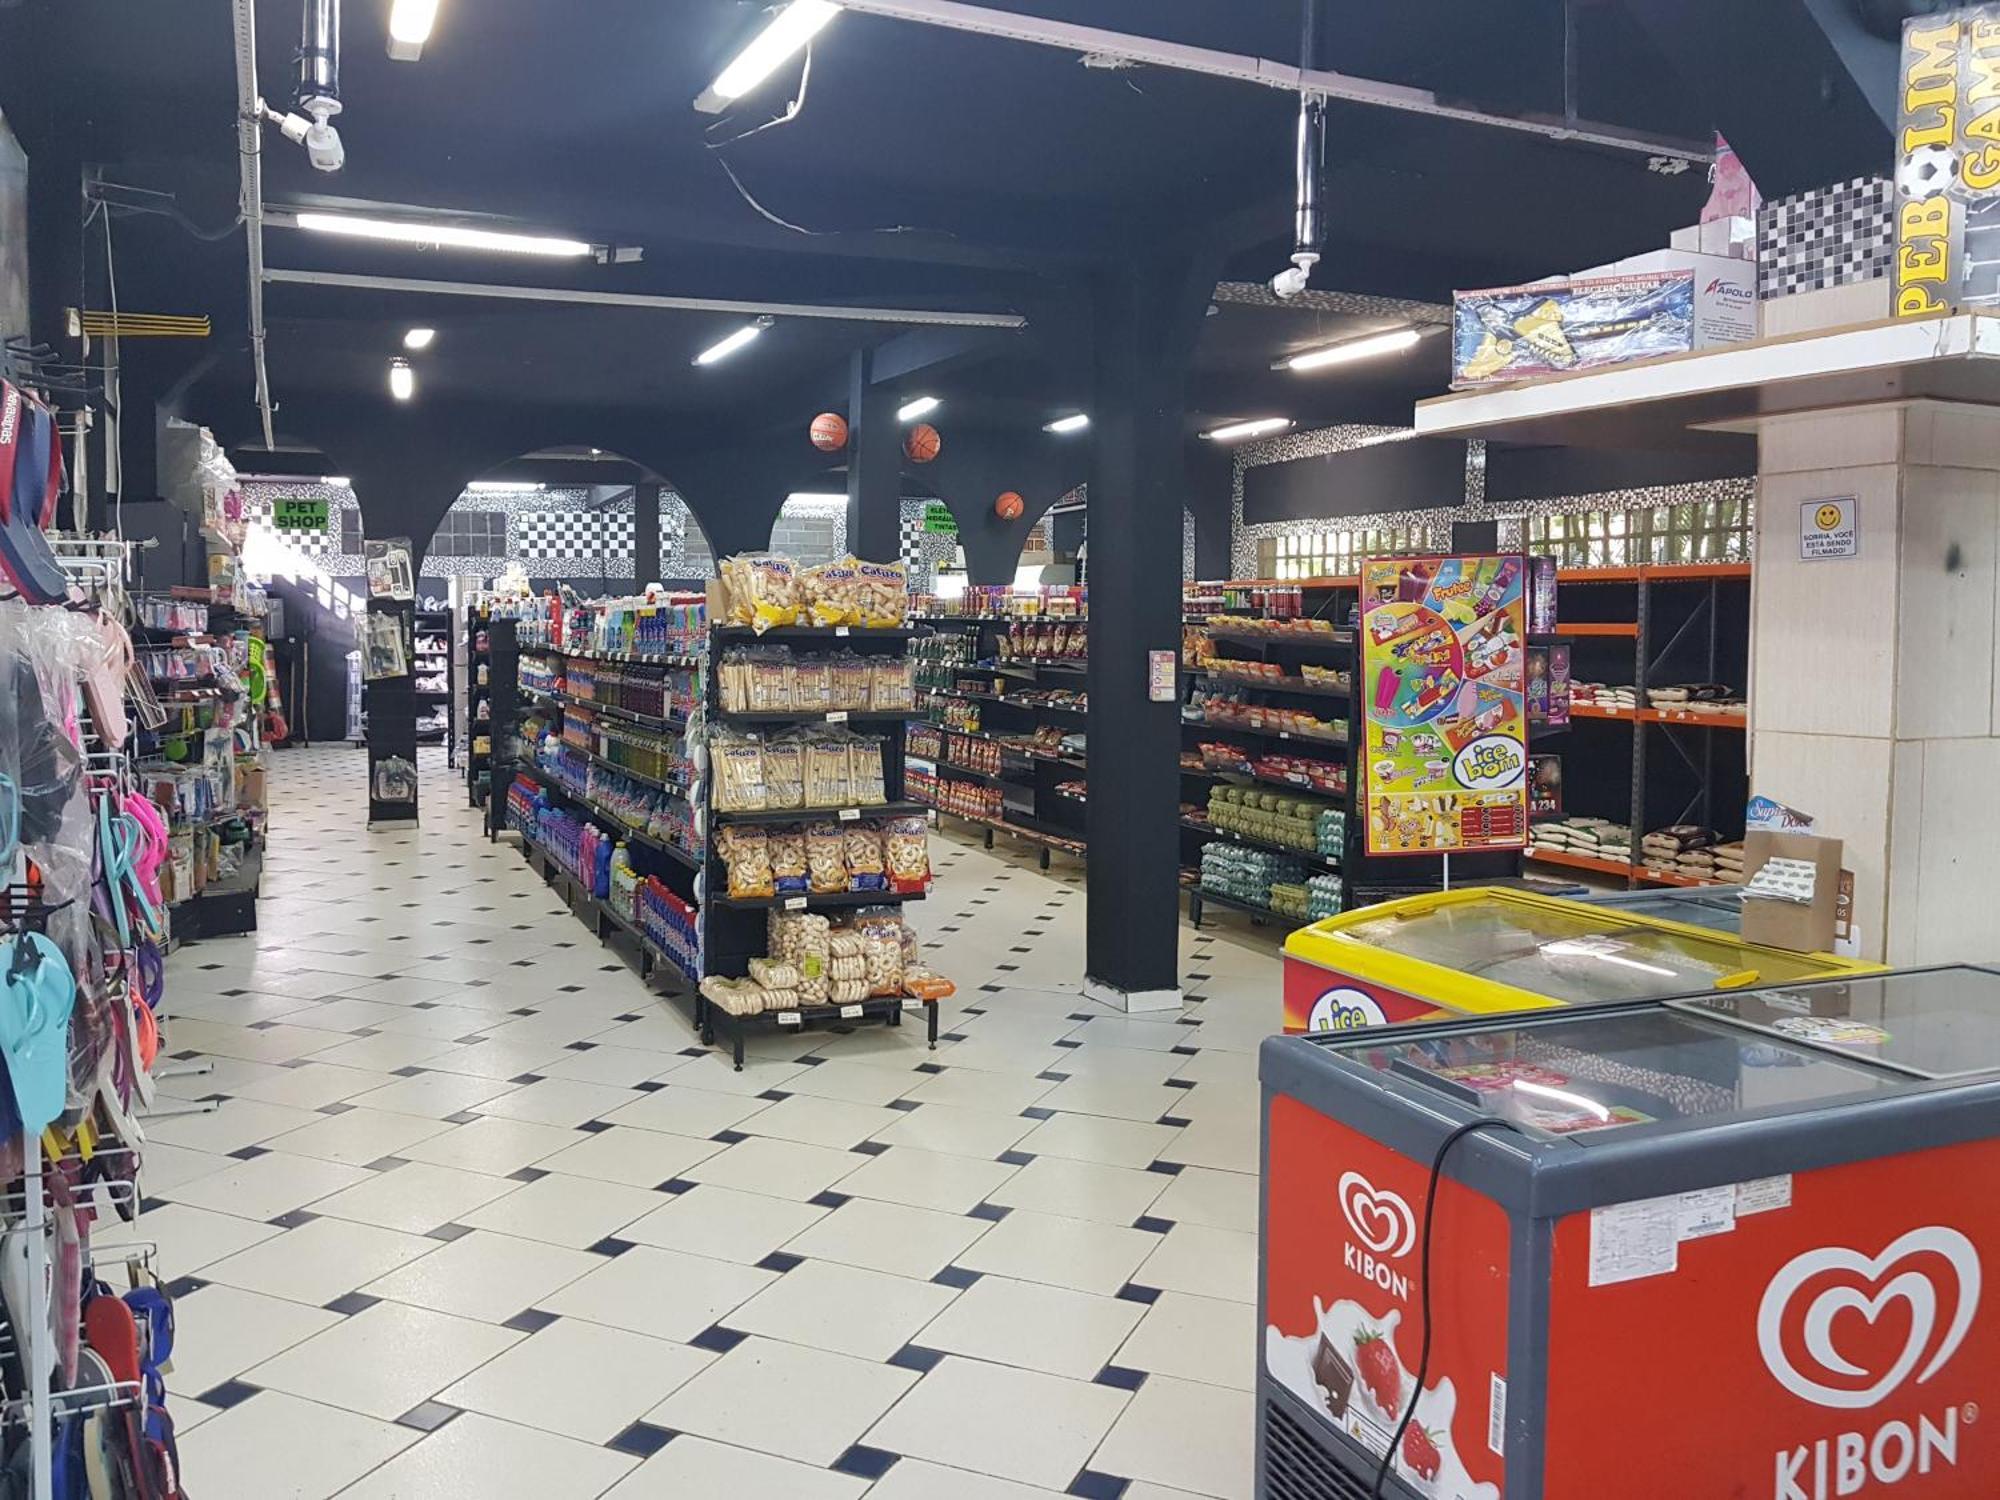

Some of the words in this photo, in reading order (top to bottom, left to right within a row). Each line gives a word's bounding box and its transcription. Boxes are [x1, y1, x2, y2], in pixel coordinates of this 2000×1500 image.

[1717, 286, 1753, 298] APOLO
[286, 502, 317, 513] PET
[278, 516, 326, 527] SHOP
[1804, 533, 1832, 541] SORRIA,
[1834, 530, 1854, 538] VOCÊ
[1827, 539, 1852, 547] SENDO
[861, 566, 903, 579] Cafuzo
[1473, 744, 1509, 765] ice
[1461, 753, 1521, 782] bom
[1538, 800, 1556, 811] 234
[1344, 1241, 1407, 1302] KIBON
[1775, 1407, 1958, 1500] KIBON
